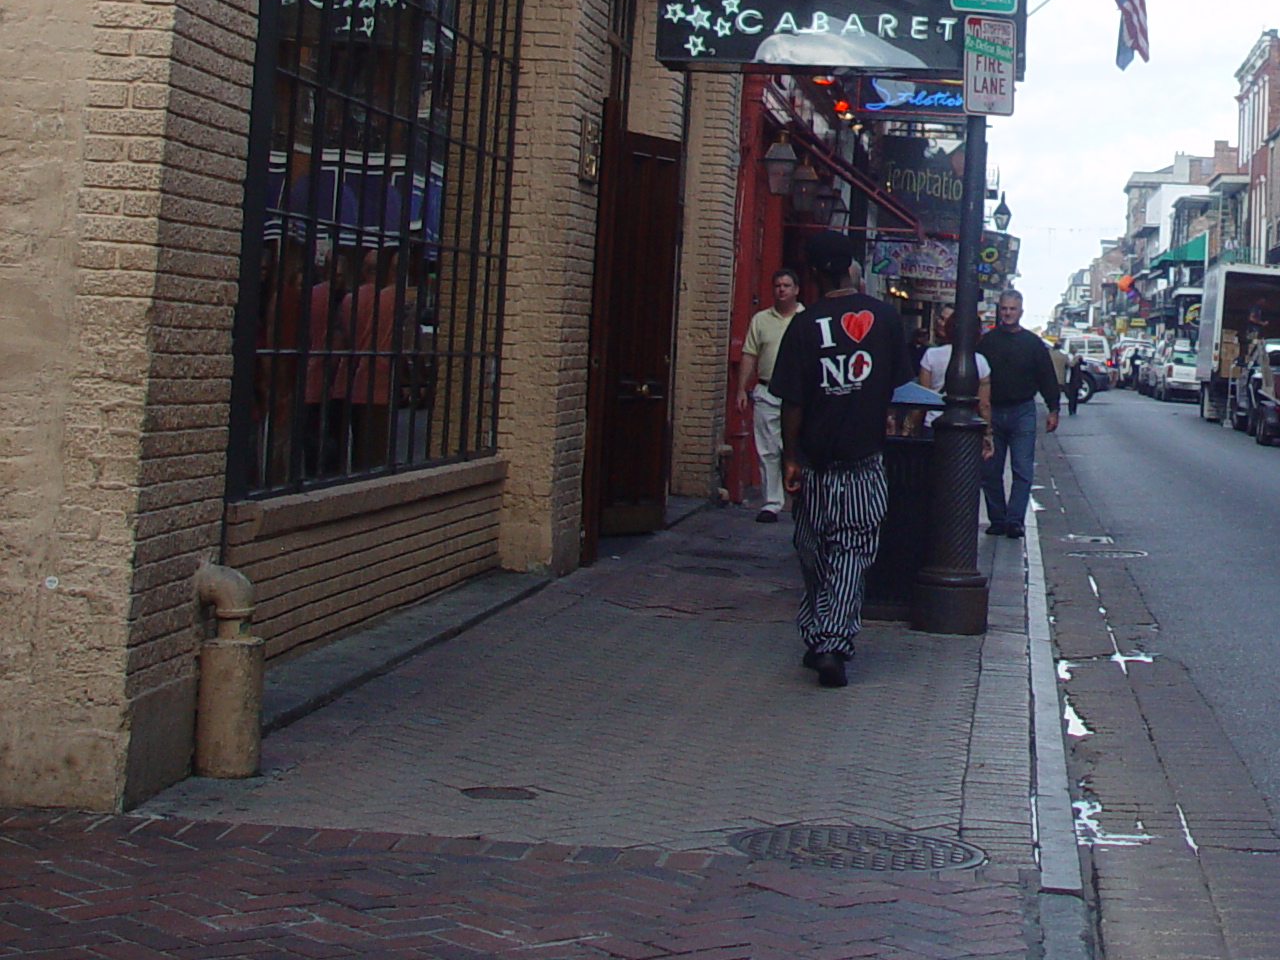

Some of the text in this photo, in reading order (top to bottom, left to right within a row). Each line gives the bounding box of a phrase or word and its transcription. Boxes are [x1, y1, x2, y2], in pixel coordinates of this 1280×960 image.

[734, 9, 959, 42] CABARET
[976, 52, 1004, 74] FIRE
[973, 74, 1006, 96] LANE
[886, 161, 964, 202] Temptatio
[815, 316, 837, 348] I
[819, 349, 873, 388] NO
